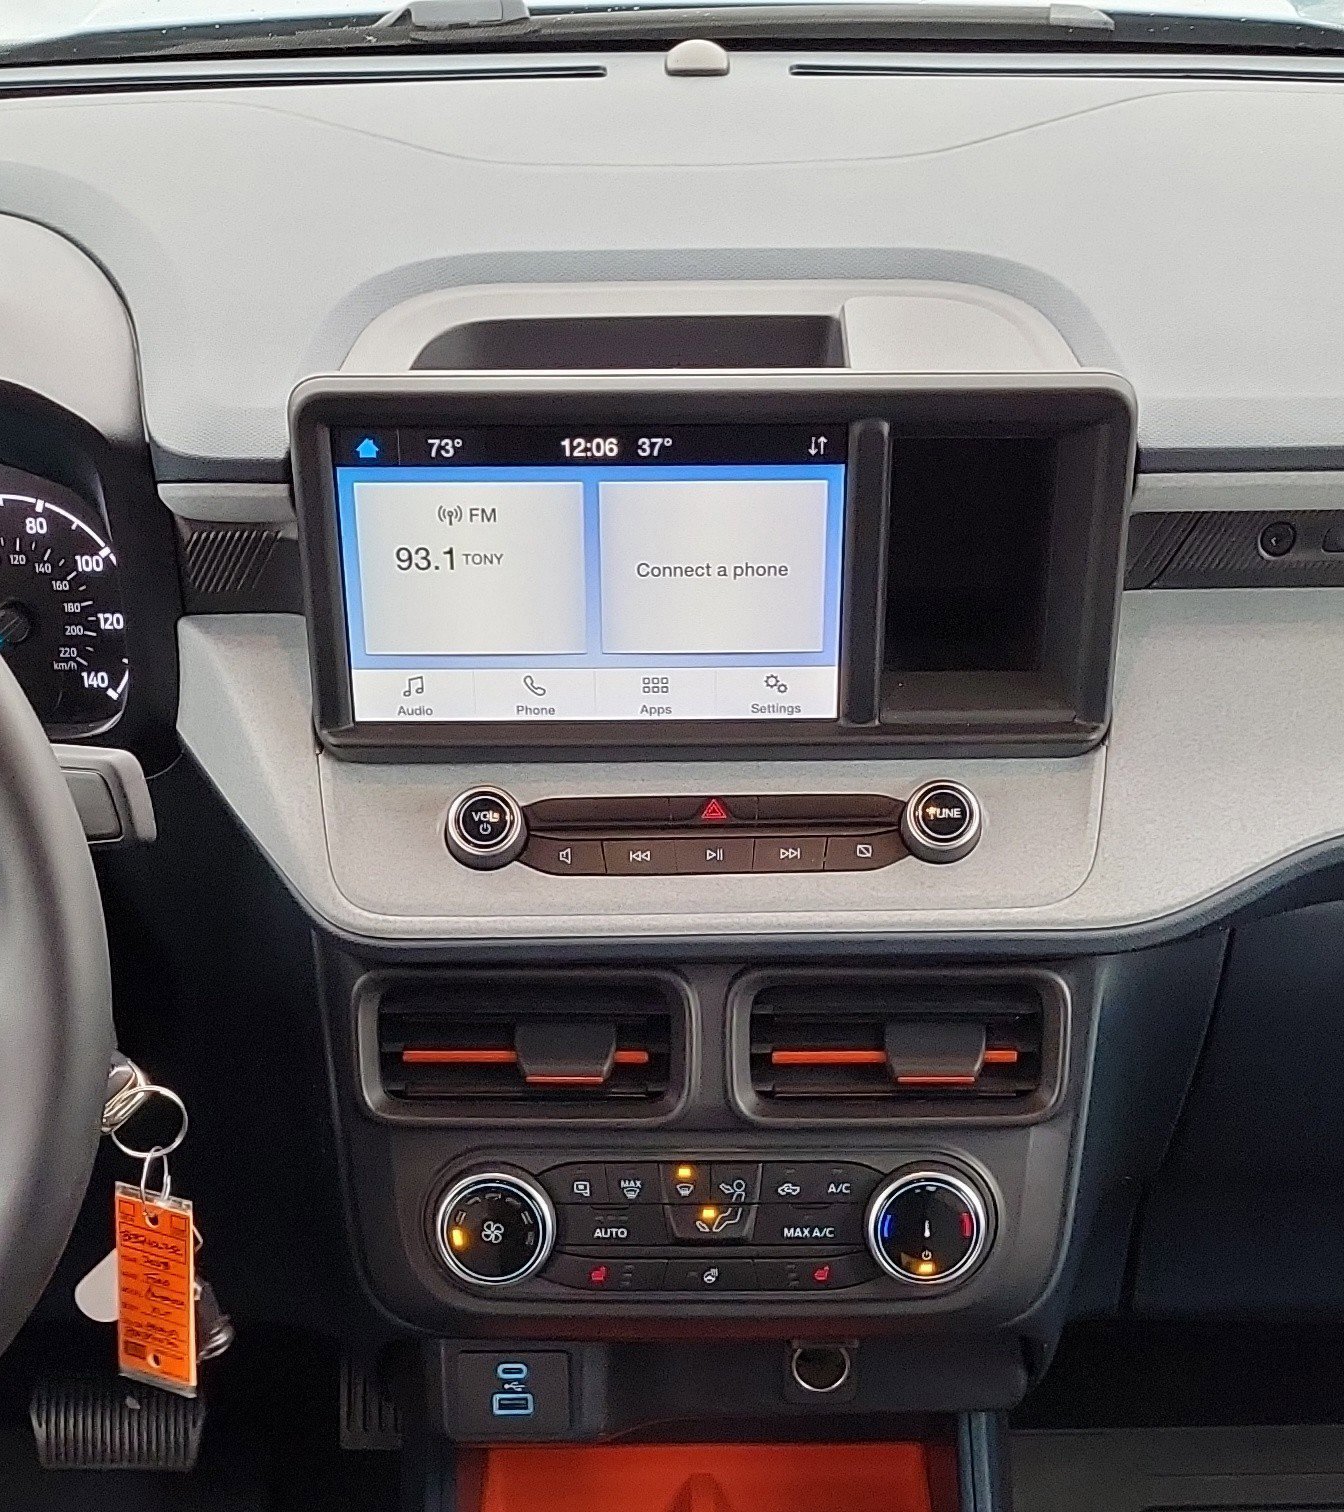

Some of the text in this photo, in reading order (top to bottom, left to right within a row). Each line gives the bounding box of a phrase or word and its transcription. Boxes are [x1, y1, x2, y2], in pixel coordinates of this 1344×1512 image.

[427, 438, 463, 458] 73°
[560, 438, 619, 458] 12:06
[637, 438, 673, 458] 37°
[469, 507, 498, 524] FM
[25, 517, 48, 534] 80
[9, 555, 26, 565] 120
[74, 555, 104, 572] 100
[395, 547, 504, 572] 93.1 TONY
[34, 562, 52, 574] 140
[636, 561, 789, 581] Connect a phone
[52, 580, 69, 591] 160
[63, 602, 81, 613] 180
[97, 613, 124, 630] 120
[64, 625, 84, 636] 200
[59, 647, 77, 658] 220
[53, 660, 78, 671] km/h
[81, 671, 109, 688] 140
[397, 704, 434, 717] Audio
[515, 704, 556, 717] Phone
[640, 704, 673, 718] Apps
[750, 702, 802, 718] Settings
[471, 811, 500, 823] VOL
[926, 806, 962, 820] TUNE
[620, 1179, 642, 1189] MAX
[827, 1183, 851, 1194] A/C
[593, 1227, 628, 1239] AUTO
[783, 1227, 835, 1239] MAX A/C
